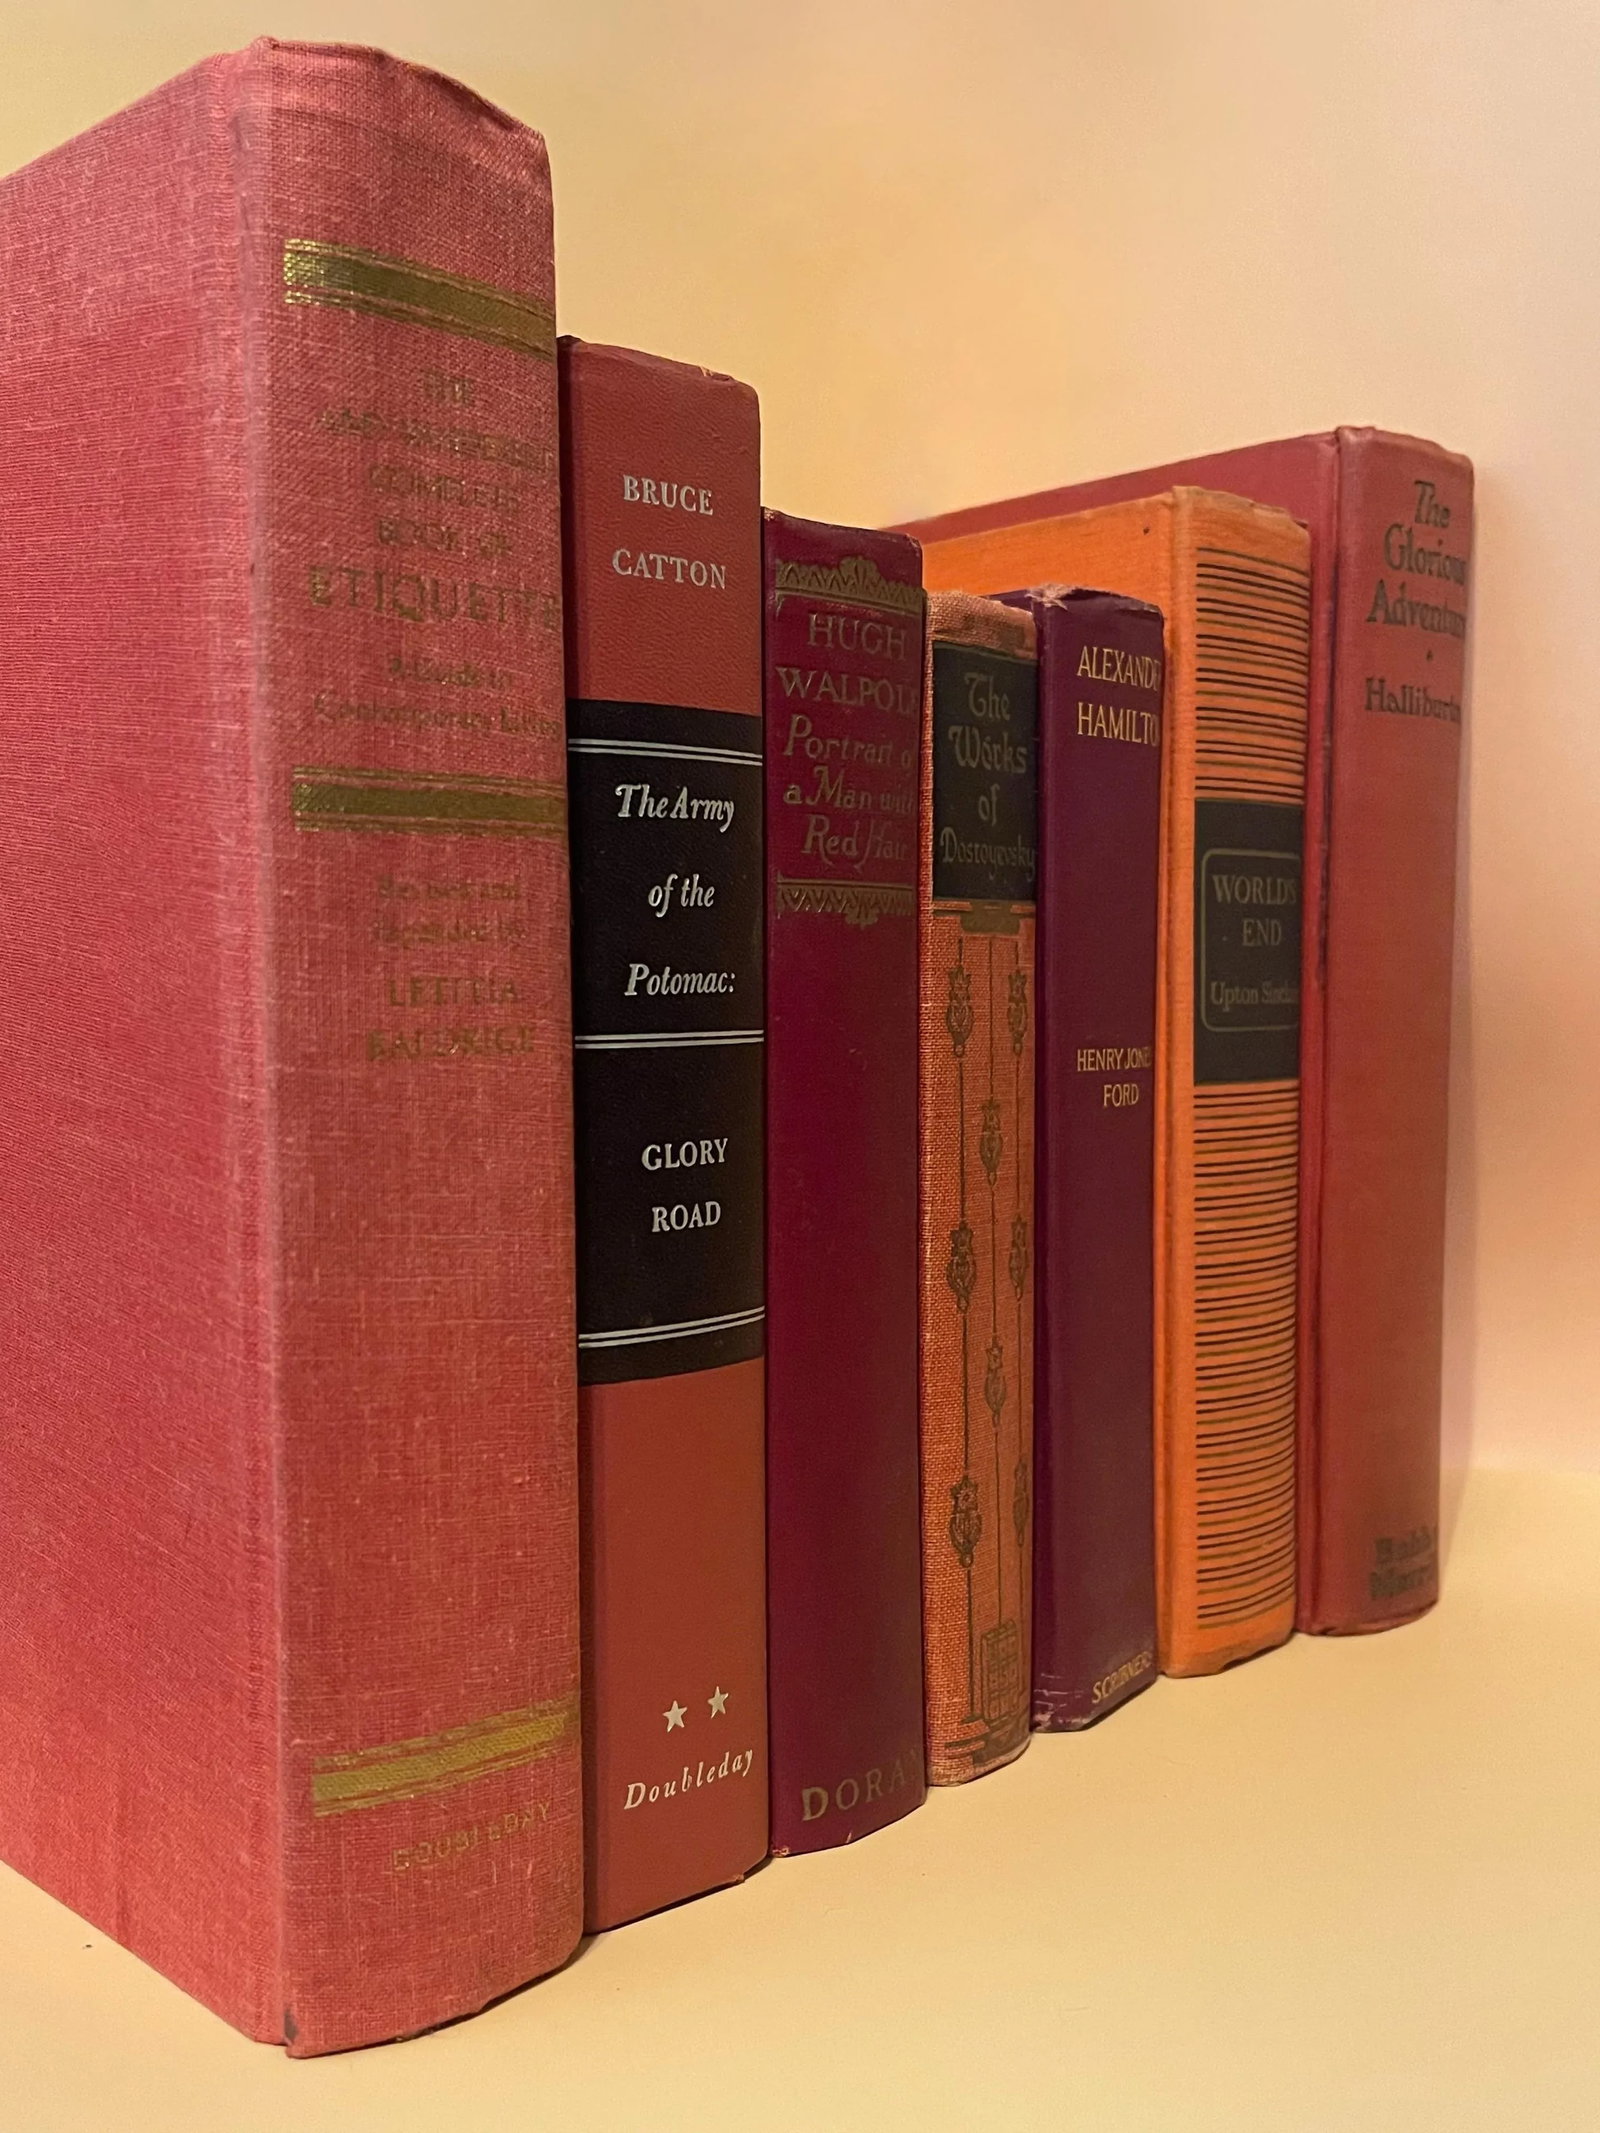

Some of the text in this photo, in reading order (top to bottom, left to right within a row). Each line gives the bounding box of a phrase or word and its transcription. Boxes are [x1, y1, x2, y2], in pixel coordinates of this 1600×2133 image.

[623, 474, 713, 516] BRUCE
[1414, 480, 1450, 528] The
[612, 549, 726, 590] CATTON
[807, 613, 906, 660] HUGH
[964, 672, 1010, 721] The
[784, 713, 892, 768] Portrait
[948, 725, 1028, 773] Works
[615, 784, 735, 833] The Army
[784, 785, 802, 805] a
[804, 765, 873, 811] Man
[978, 784, 1000, 827] of
[801, 813, 908, 875] Red Hair
[648, 874, 716, 918] of the
[1242, 919, 1282, 947] END
[624, 963, 736, 997] Potomac:
[1210, 981, 1259, 1012] Upton
[1077, 1048, 1124, 1071] HENRY
[1103, 1084, 1139, 1107] FORD
[641, 1138, 728, 1171] GLORY
[652, 1201, 722, 1233] ROAD
[624, 1749, 753, 1810] Doubleday
